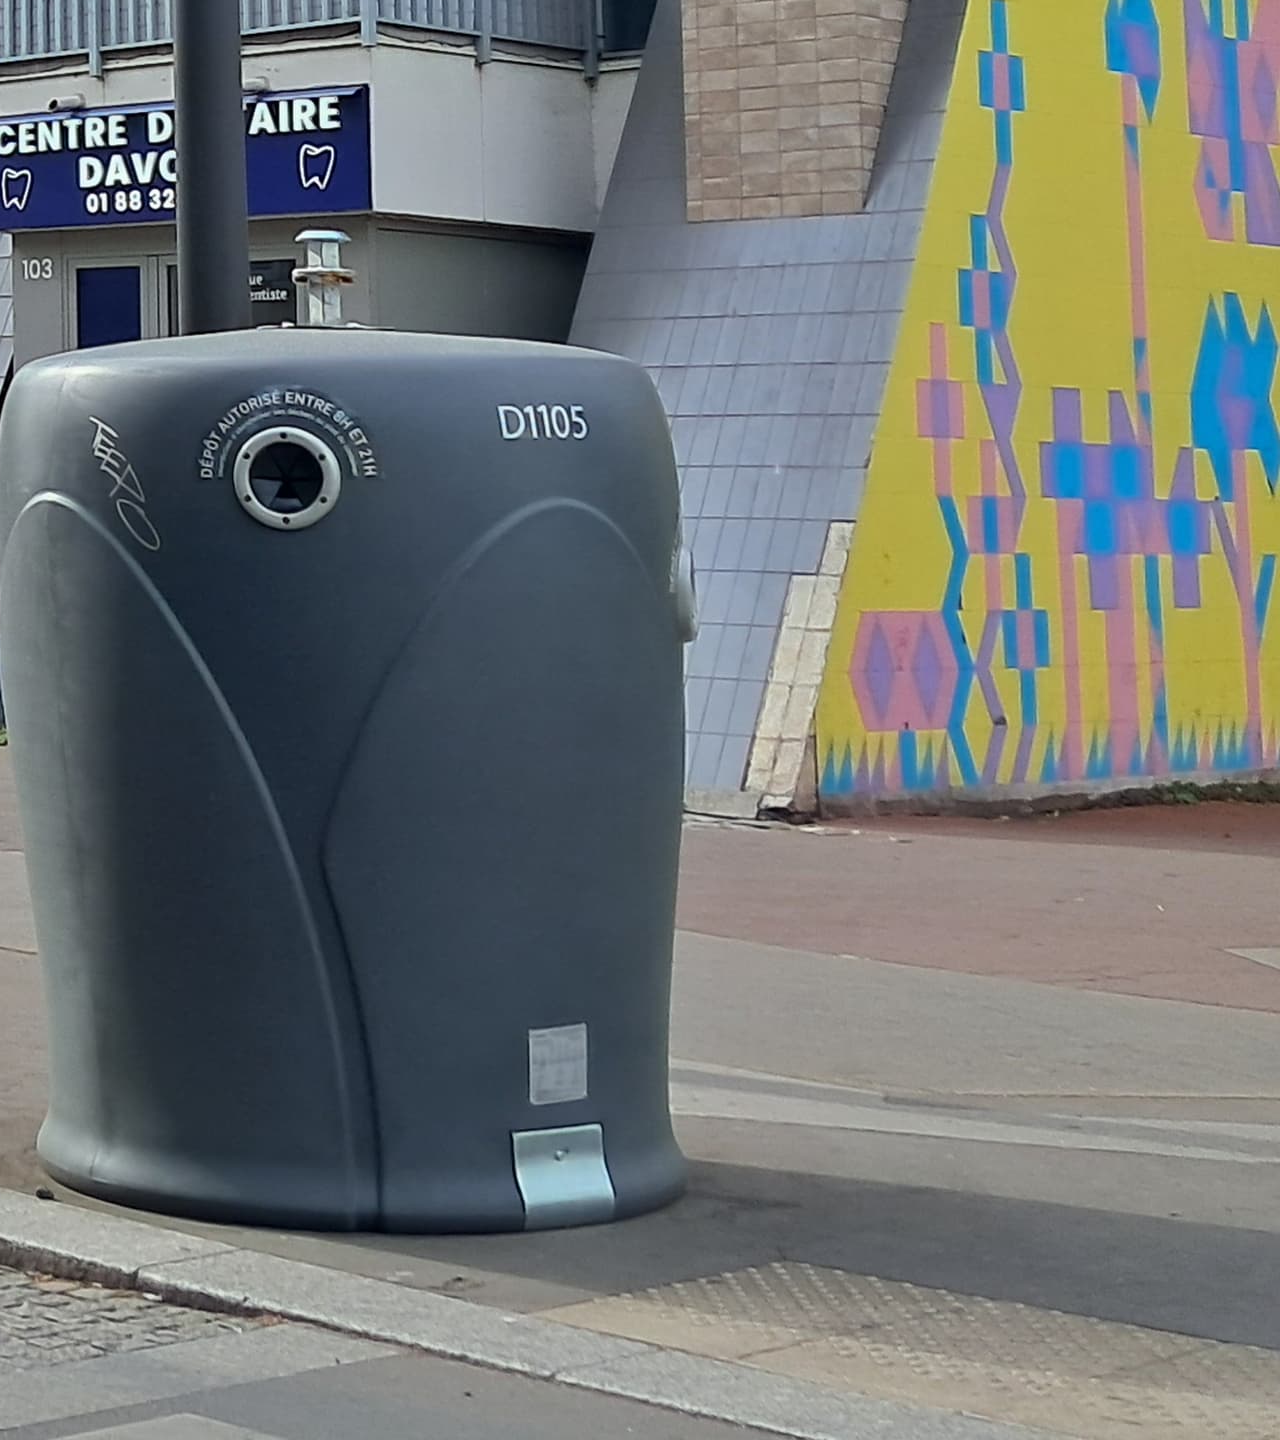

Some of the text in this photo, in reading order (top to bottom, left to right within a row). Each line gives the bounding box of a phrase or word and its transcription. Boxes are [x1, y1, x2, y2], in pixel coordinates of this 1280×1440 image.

[147, 96, 342, 144] DAIRE
[78, 149, 177, 189] DAVO
[85, 188, 176, 214] 01 88 32
[21, 258, 53, 280] 103
[250, 288, 289, 301] entiste
[198, 388, 378, 479] DÉPÔT AUTORISÉ ENTRE 8H ET 21H
[497, 404, 589, 440] D1105
